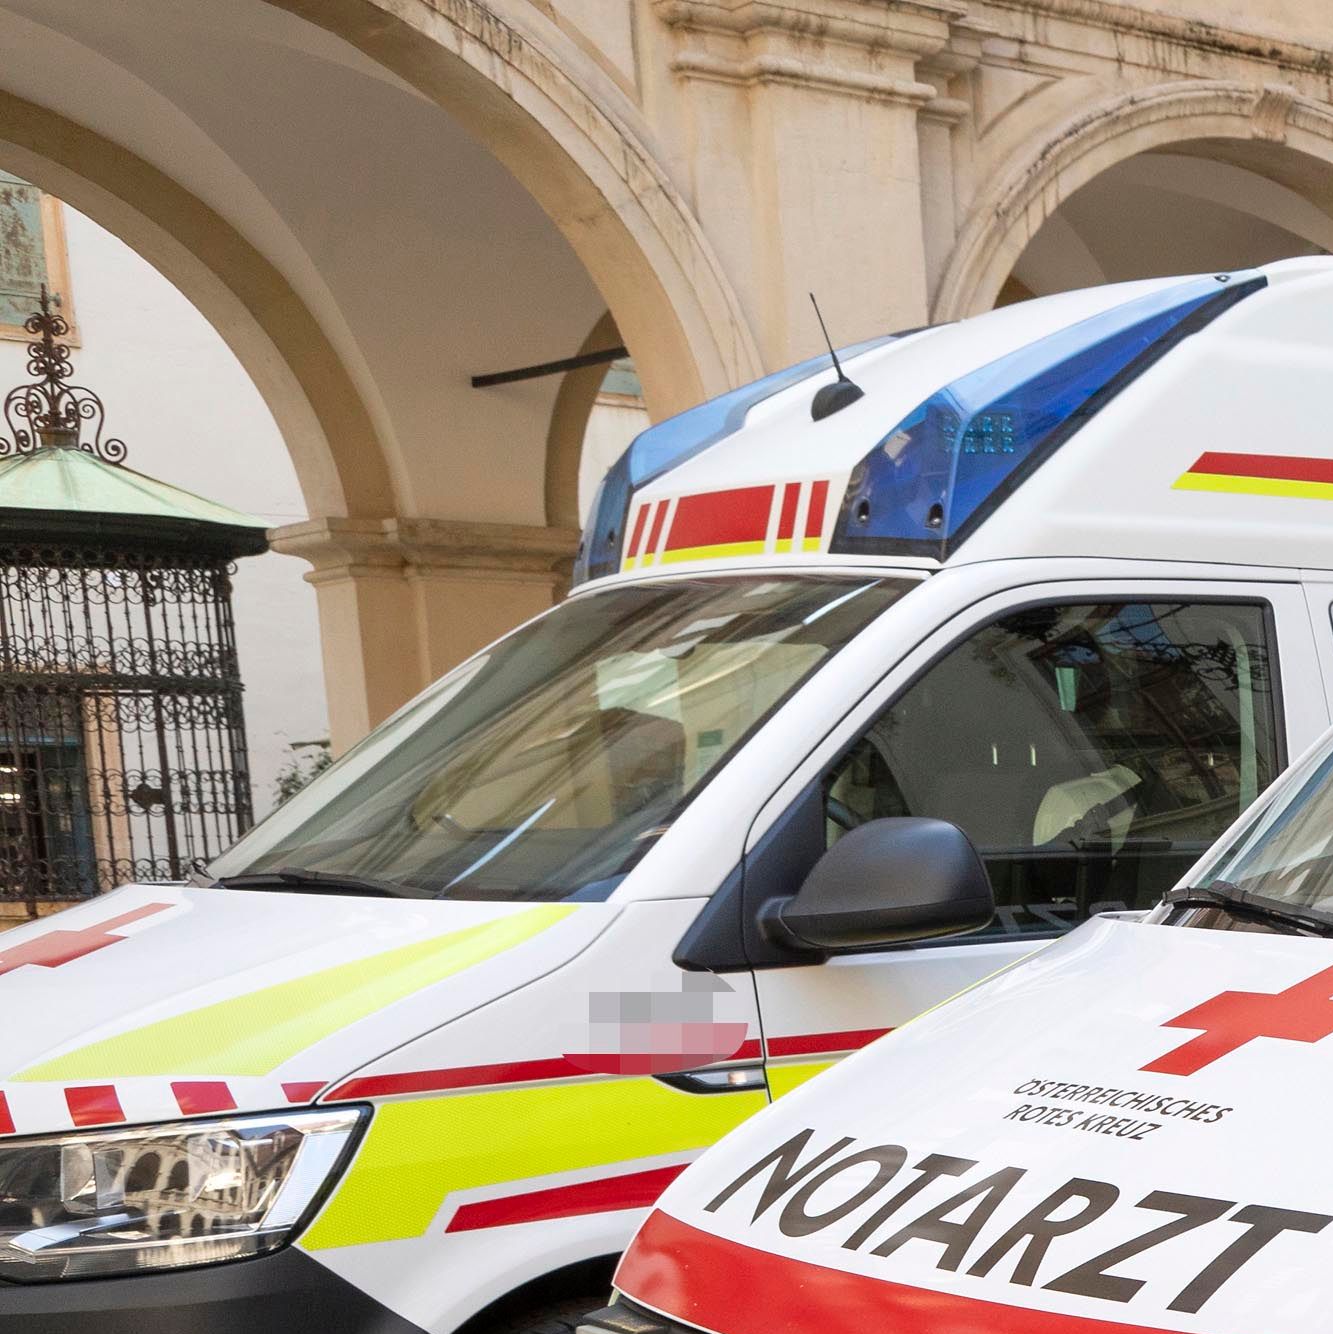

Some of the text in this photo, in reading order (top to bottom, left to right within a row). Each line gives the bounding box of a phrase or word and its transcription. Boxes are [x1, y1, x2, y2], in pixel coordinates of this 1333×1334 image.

[1013, 1078, 1234, 1124] ÖSTERREICHISCHES
[1003, 1104, 1162, 1141] ROTES KREUZ
